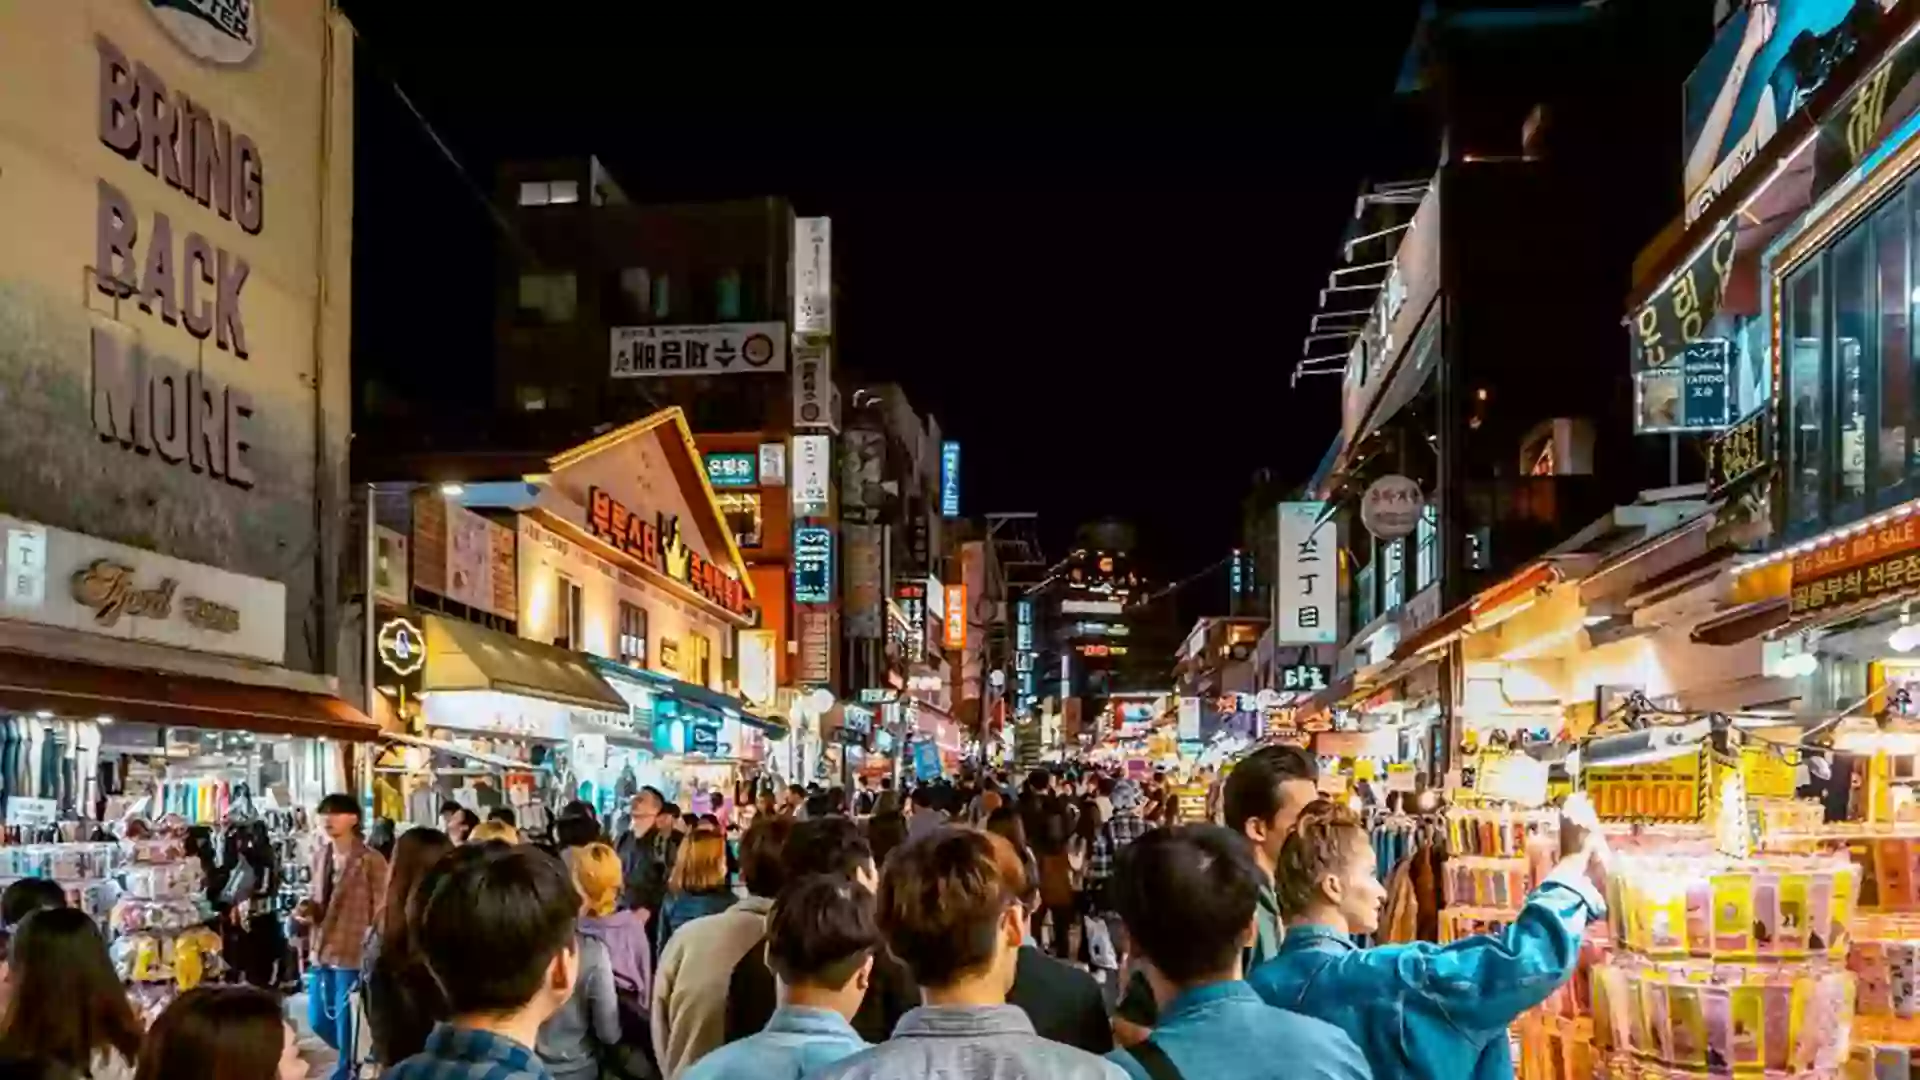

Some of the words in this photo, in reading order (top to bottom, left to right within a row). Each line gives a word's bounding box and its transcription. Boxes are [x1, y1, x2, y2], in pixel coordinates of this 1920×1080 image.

[97, 32, 263, 236] BRING
[97, 178, 250, 360] BACK
[91, 328, 254, 491] MORE
[1686, 375, 1724, 385] TATTOO
[1815, 544, 1846, 567] SALE
[1879, 522, 1915, 549] SALE
